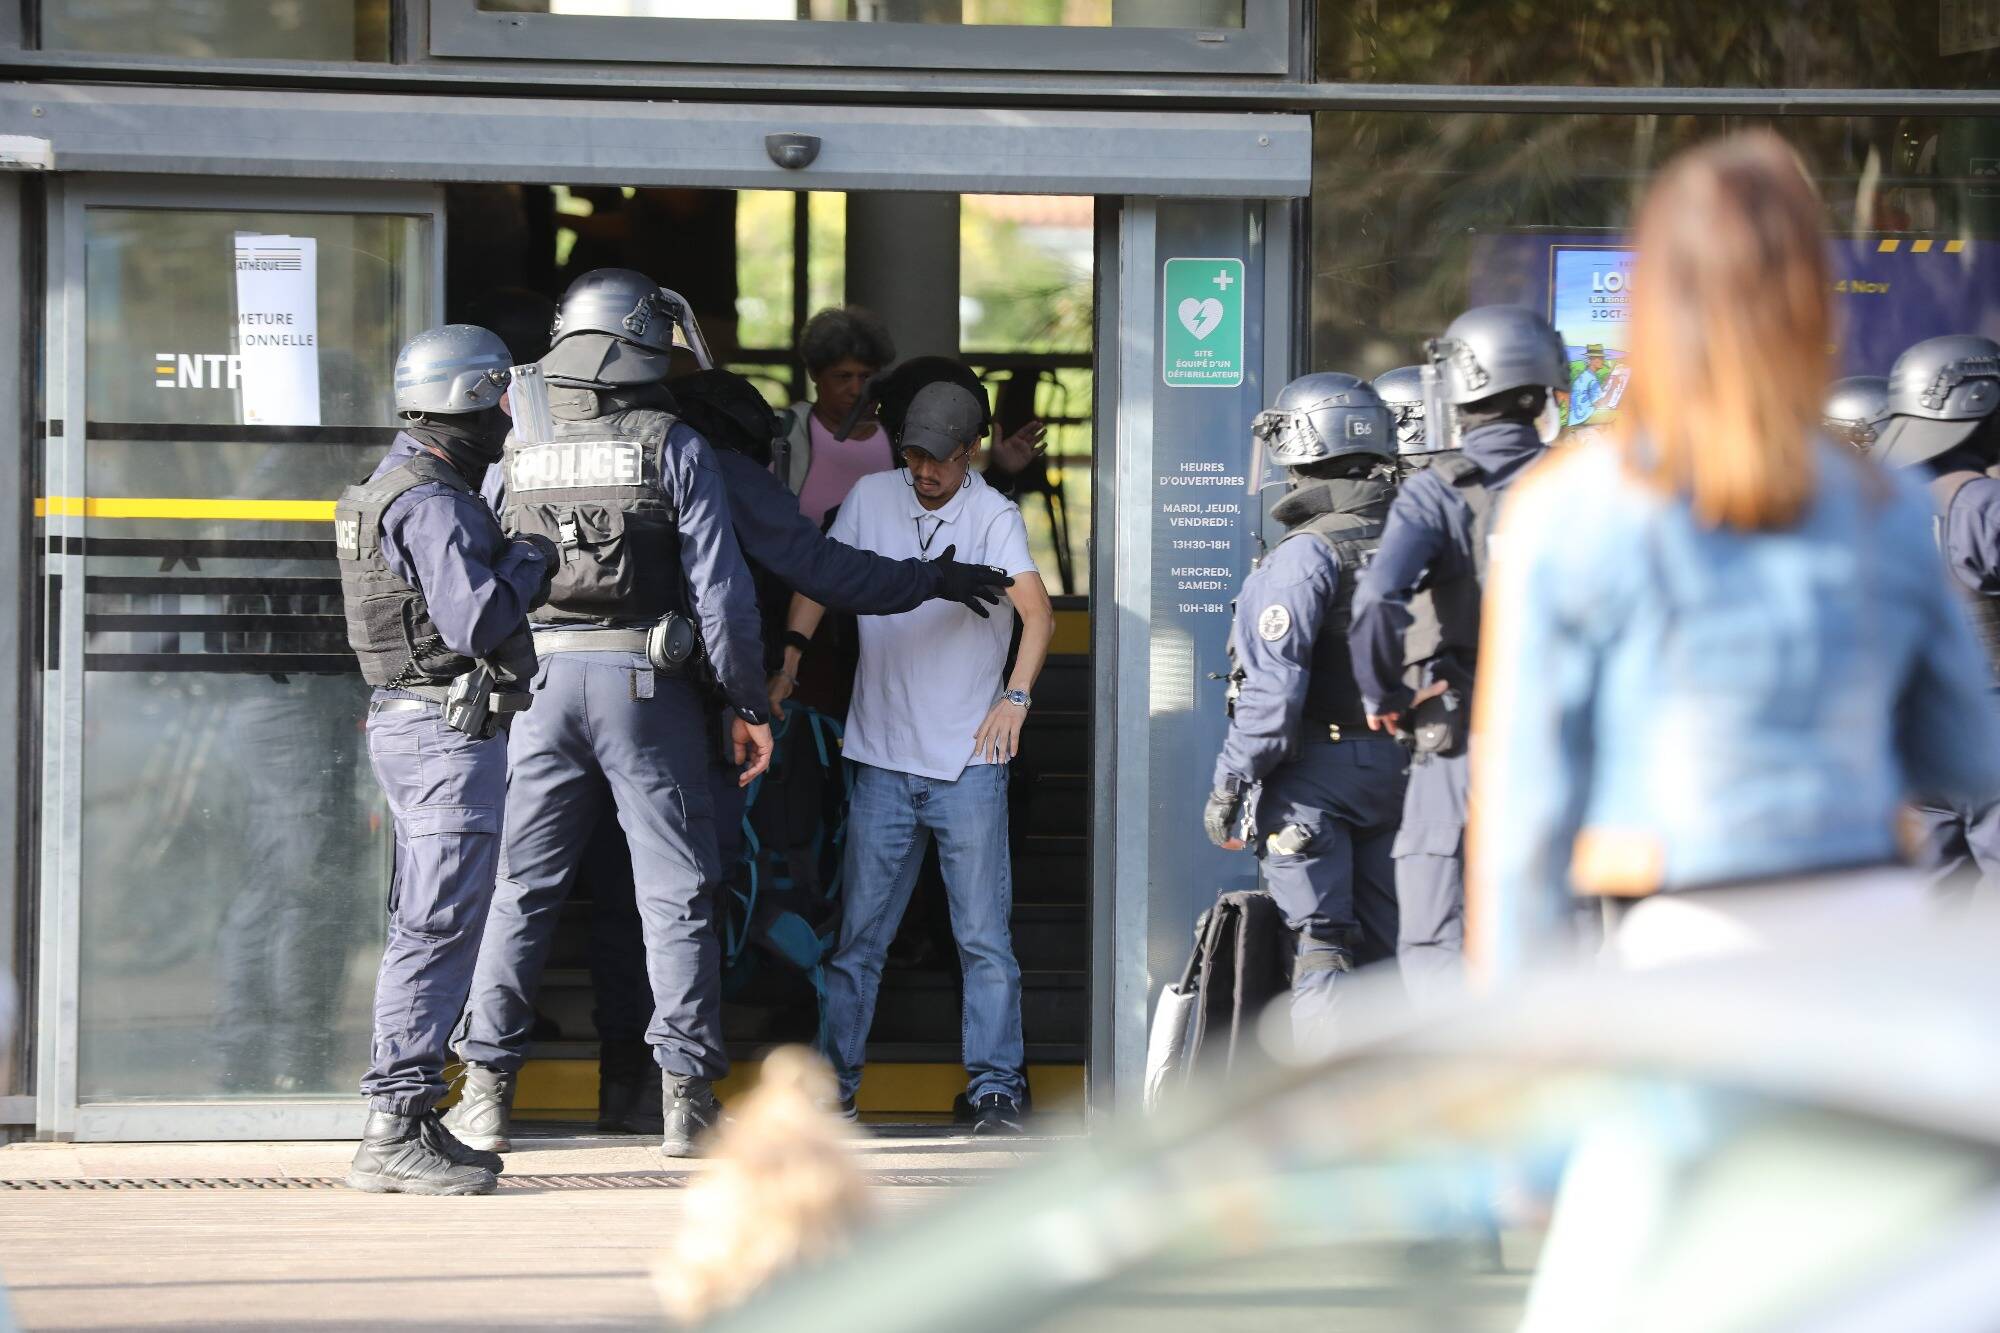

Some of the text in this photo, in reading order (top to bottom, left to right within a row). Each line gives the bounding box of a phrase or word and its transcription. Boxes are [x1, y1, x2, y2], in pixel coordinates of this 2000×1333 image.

[517, 447, 635, 482] POLICE
[1180, 462, 1225, 472] HEURES
[1163, 503, 1241, 515] MARDI, JEUDI,
[1170, 517, 1228, 527] VENDREDI
[1172, 540, 1231, 550] 13H30-18H
[1171, 567, 1232, 578] MERCREDI,
[1178, 581, 1222, 590] SAMEDI
[1178, 603, 1224, 613] 10H-18H
